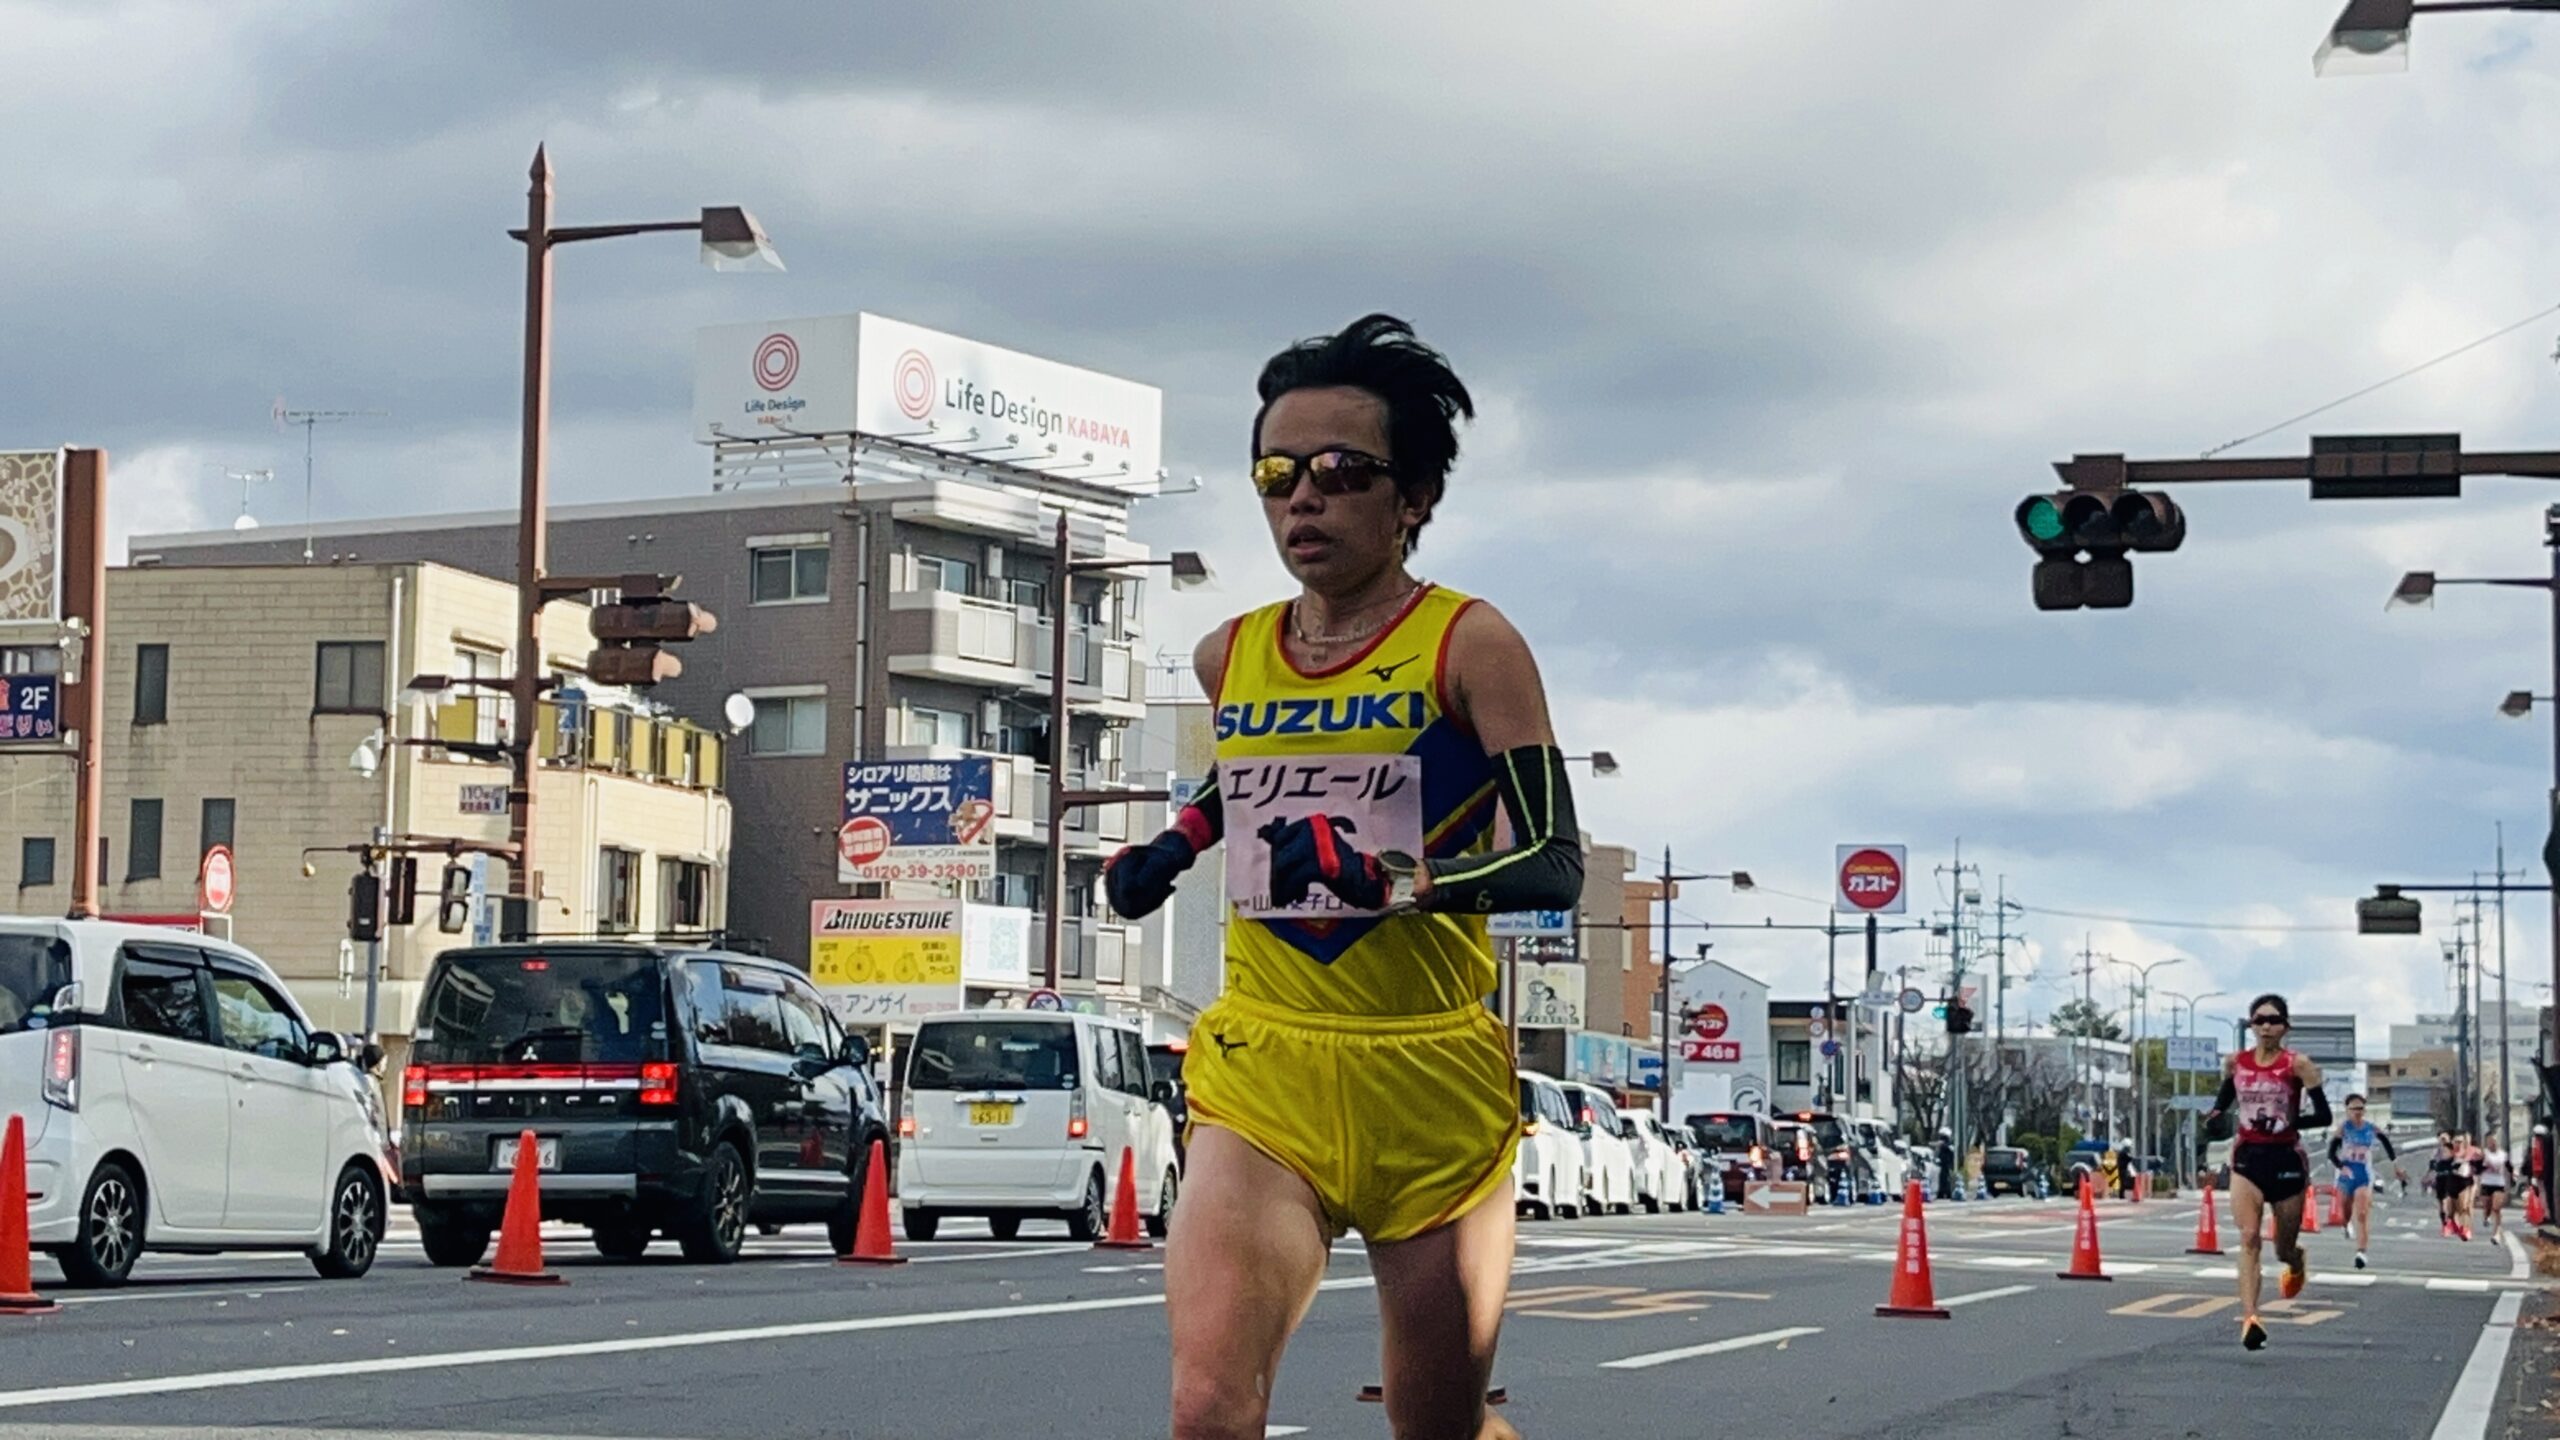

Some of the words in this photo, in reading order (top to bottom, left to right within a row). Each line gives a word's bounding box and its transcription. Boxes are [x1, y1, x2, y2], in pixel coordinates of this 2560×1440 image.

[745, 401, 765, 413] Life
[768, 396, 807, 412] Design
[944, 378, 985, 415] Life
[991, 391, 1063, 437] Design
[1068, 415, 1131, 449] KABAYA
[20, 686, 50, 711] 2F
[1217, 691, 1425, 741] SUZUKI
[1227, 763, 1407, 808] エリエール
[845, 785, 954, 813] サニックス
[863, 863, 976, 879] 0120-39-3290
[1847, 875, 1896, 892] ガスト
[824, 909, 953, 930] BRIDGESTONE
[1684, 1044, 1698, 1059] P
